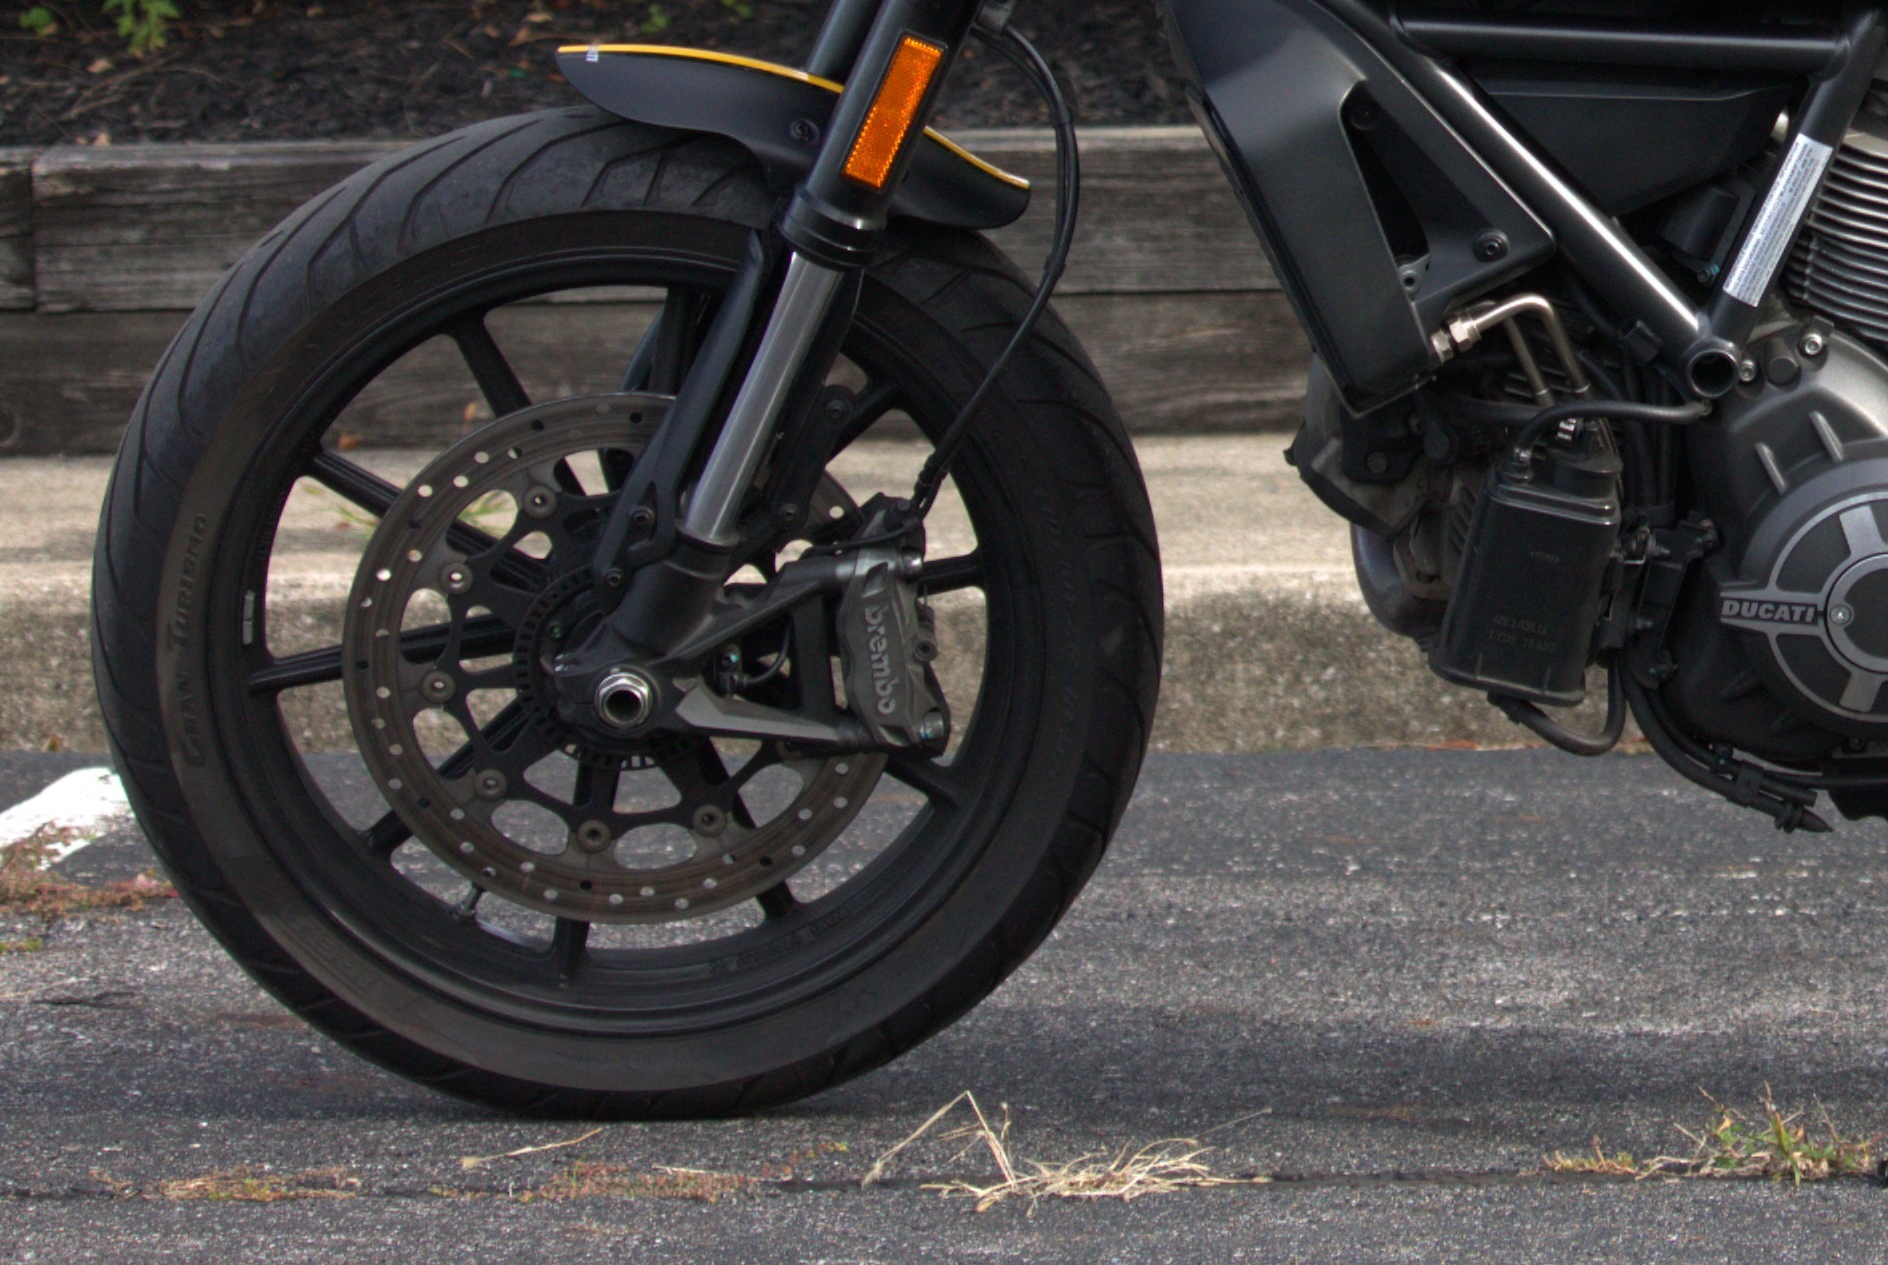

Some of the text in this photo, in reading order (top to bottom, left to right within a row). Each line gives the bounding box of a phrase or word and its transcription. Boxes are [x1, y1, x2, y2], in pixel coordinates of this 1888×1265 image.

[165, 515, 209, 768] GRAN TURISMO
[864, 605, 897, 715] brembo
[1720, 598, 1818, 624] DUCATI
